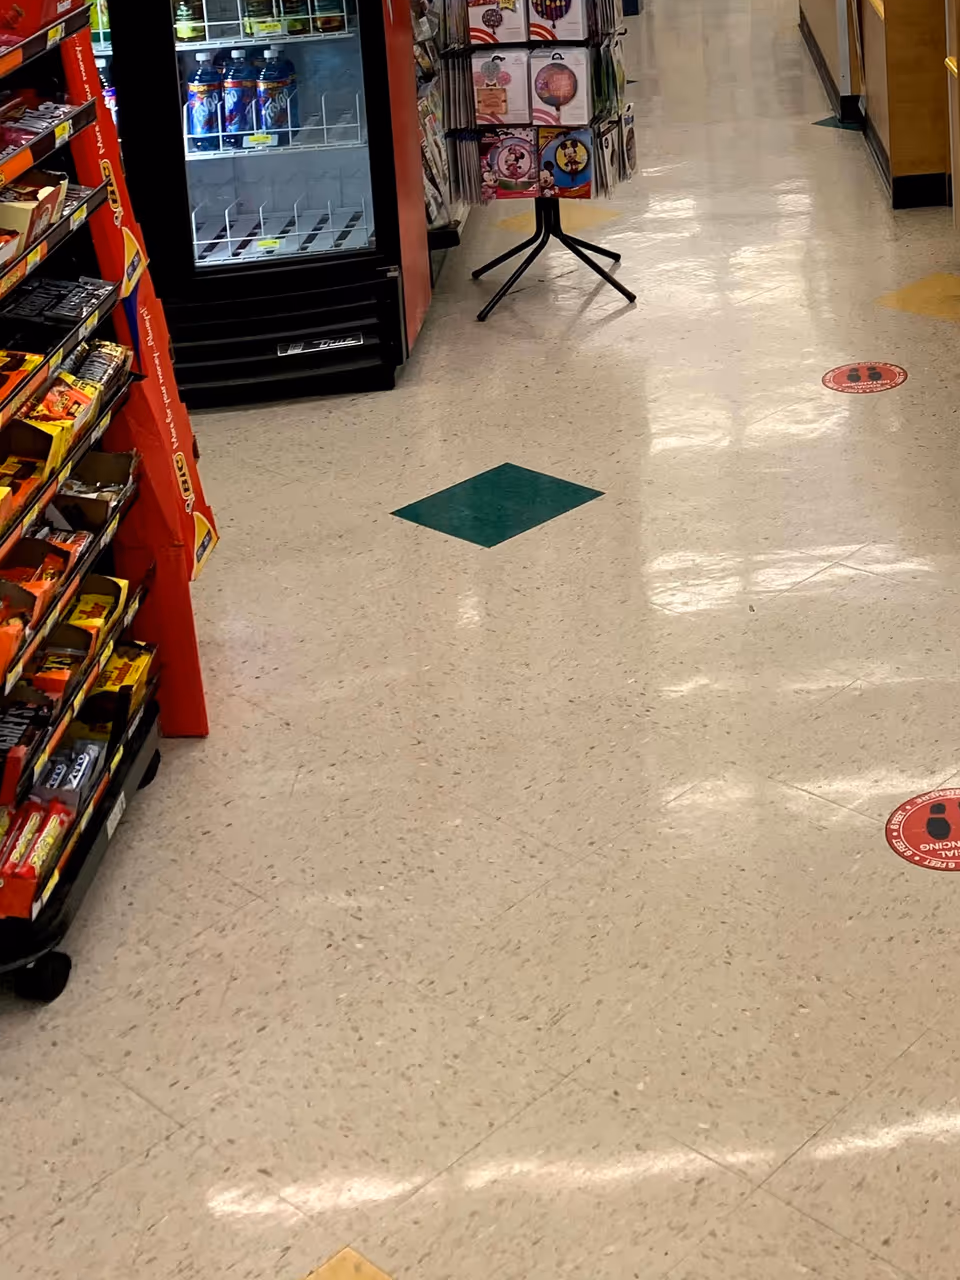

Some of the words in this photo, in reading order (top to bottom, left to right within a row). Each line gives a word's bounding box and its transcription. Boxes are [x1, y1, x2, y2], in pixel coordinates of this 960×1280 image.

[174, 452, 192, 500] BIC
[68, 752, 90, 790] Zero
[923, 859, 947, 868] FEET
